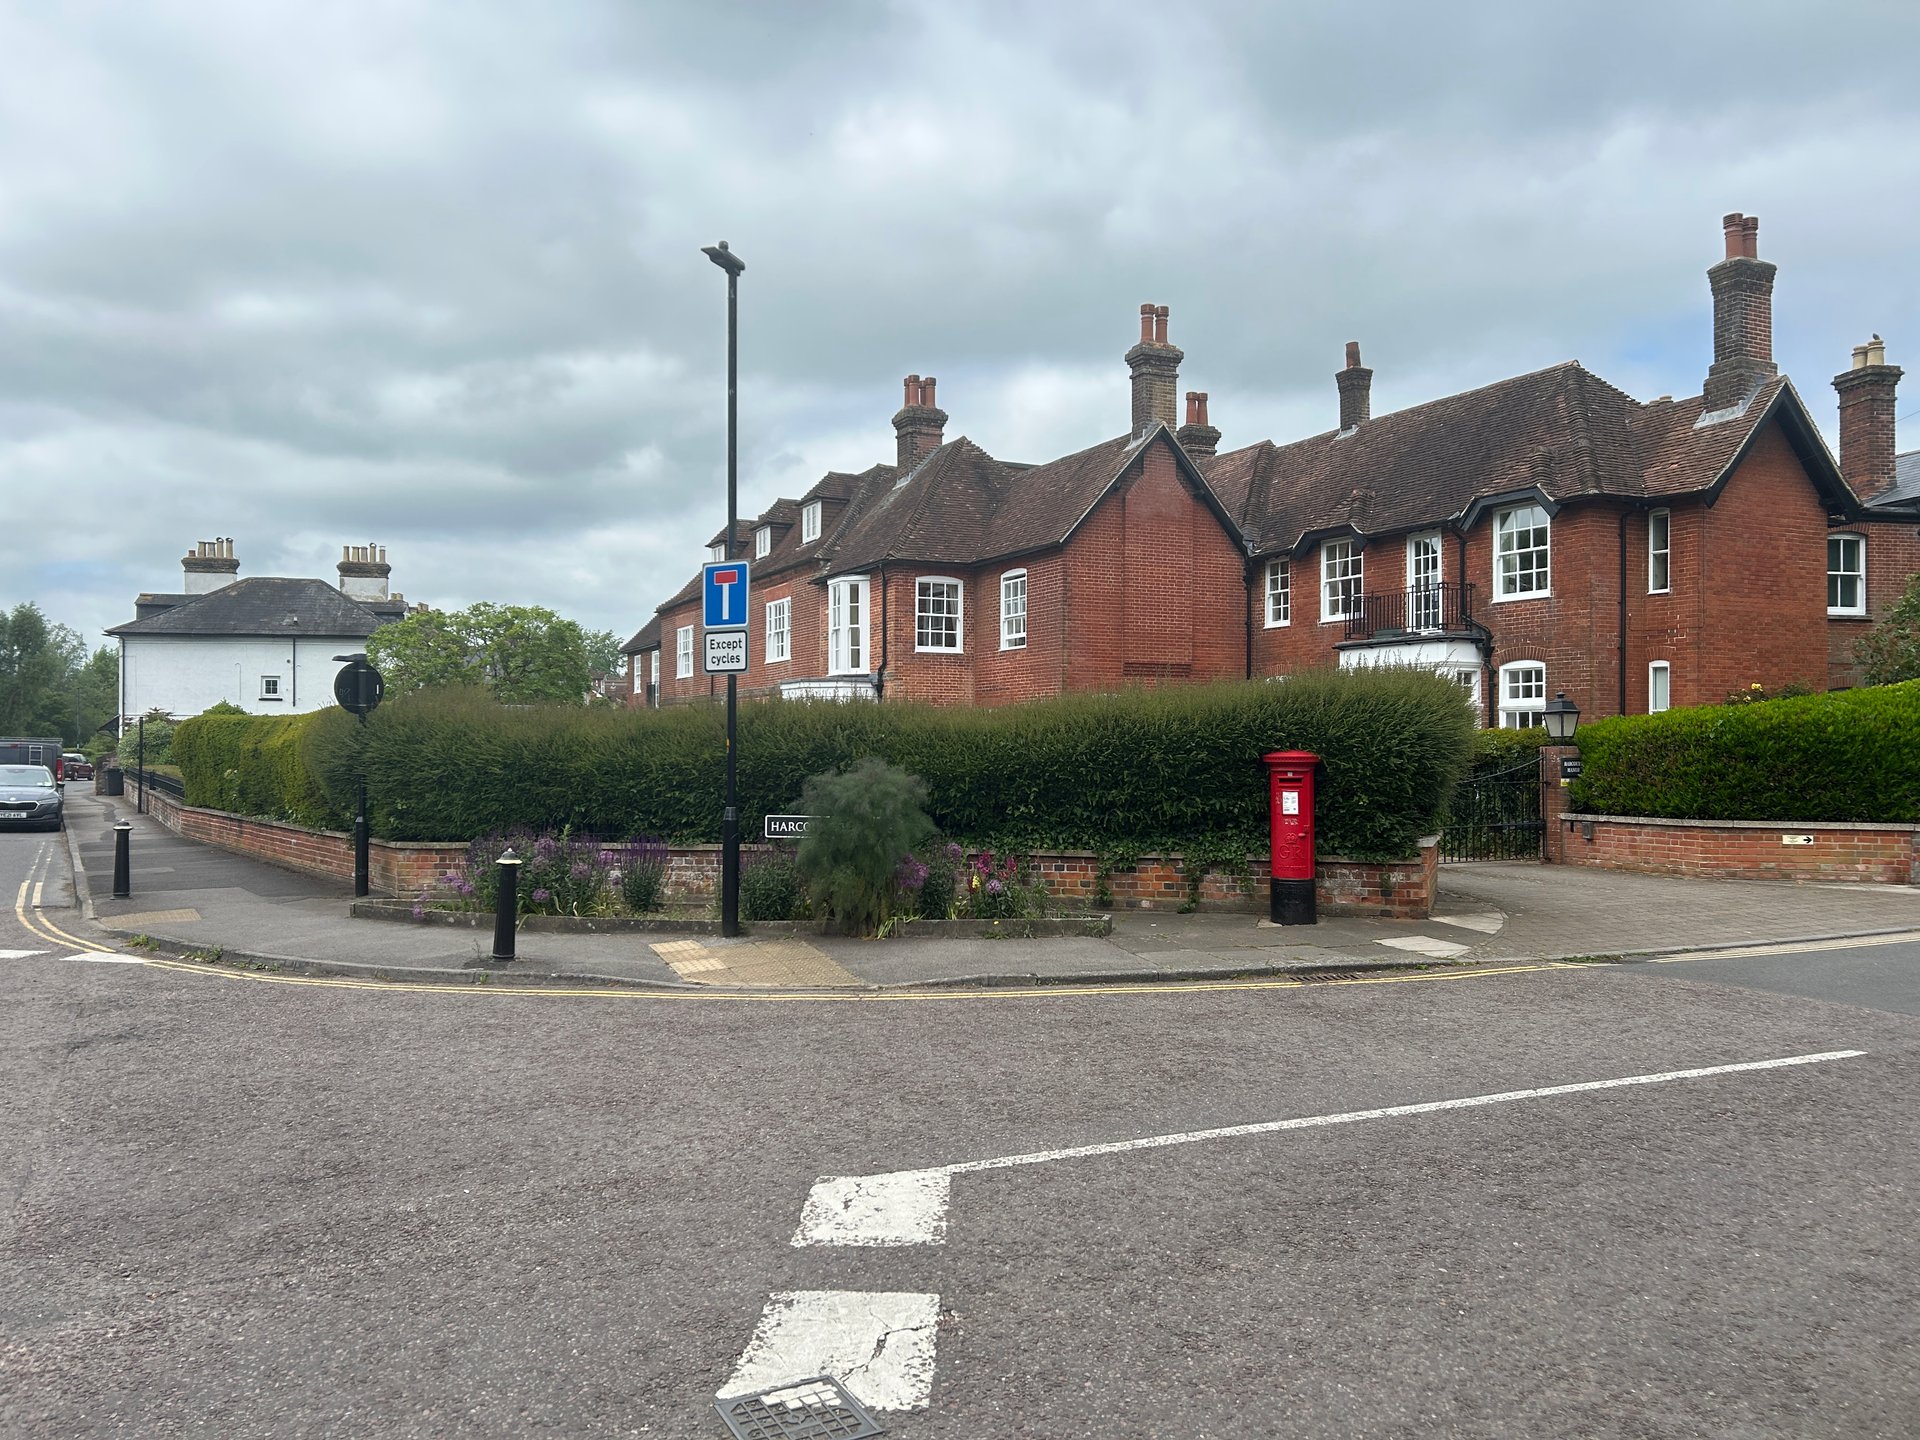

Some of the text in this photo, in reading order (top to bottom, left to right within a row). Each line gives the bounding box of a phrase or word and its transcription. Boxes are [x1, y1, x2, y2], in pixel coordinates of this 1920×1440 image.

[710, 638, 742, 651] Except
[711, 653, 741, 666] cycles
[771, 821, 810, 832] HARCO
